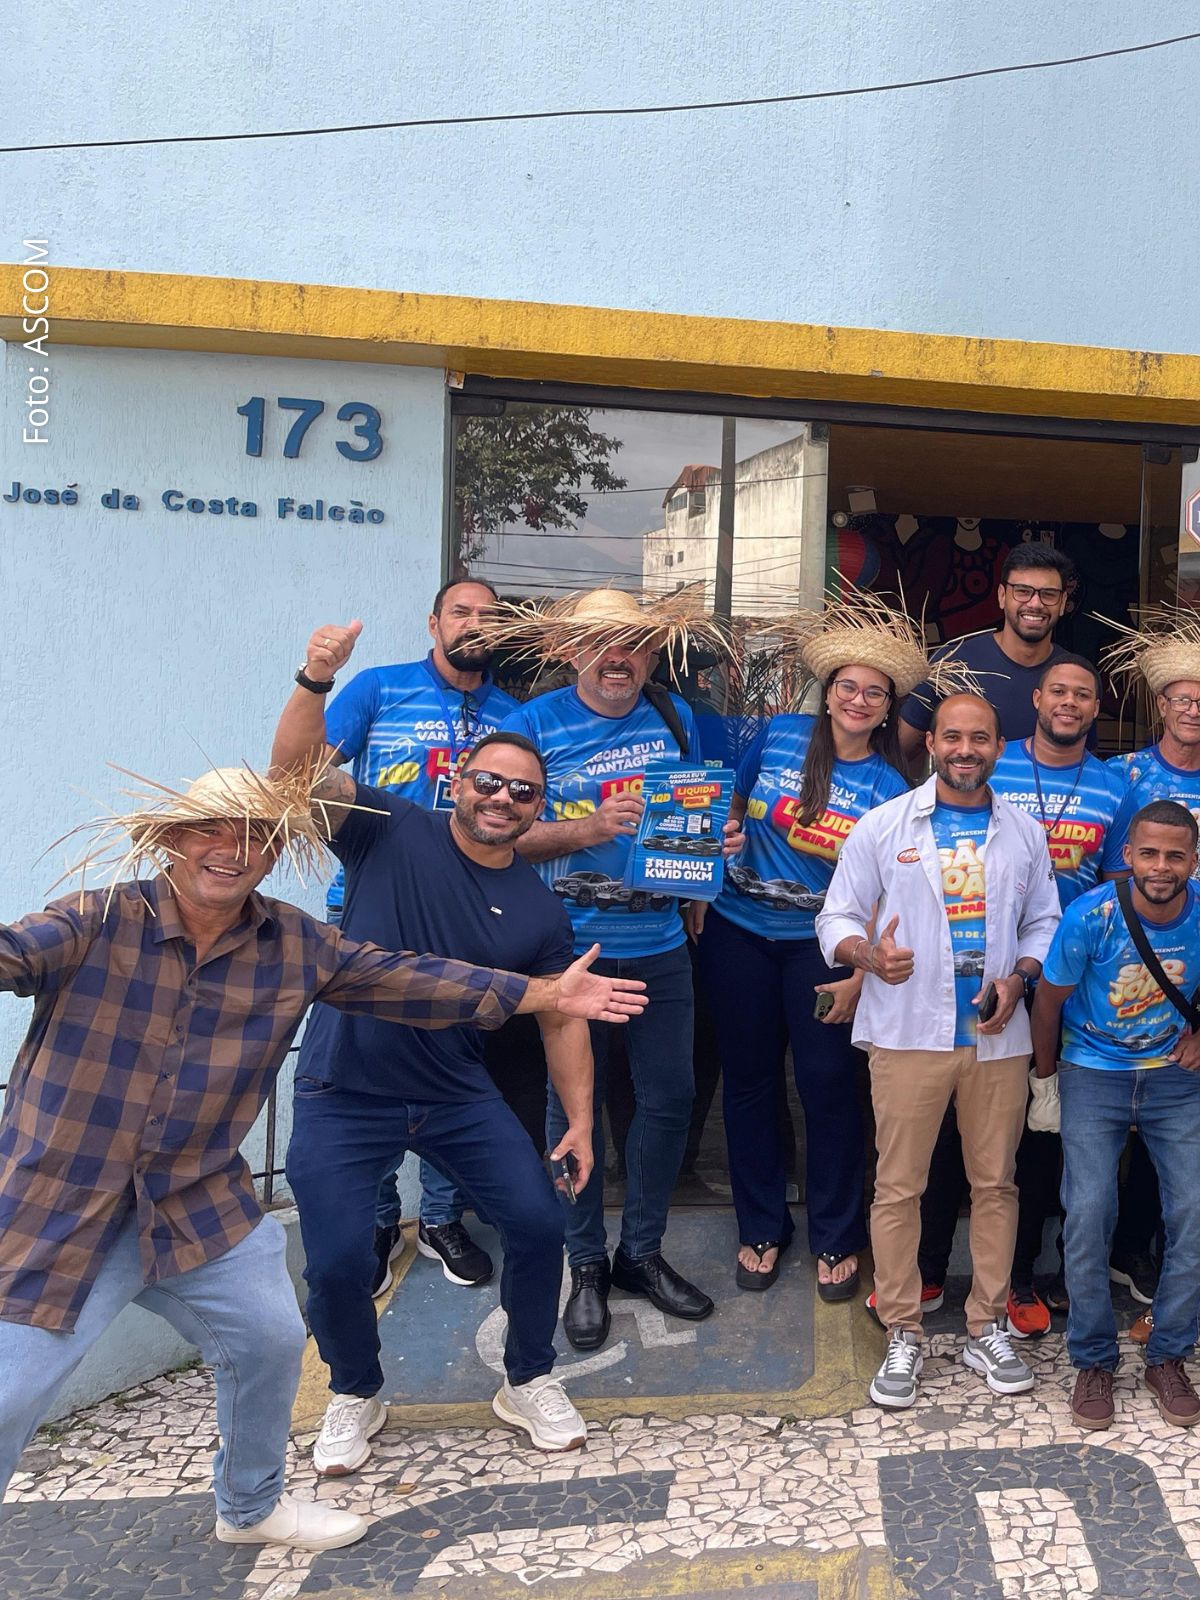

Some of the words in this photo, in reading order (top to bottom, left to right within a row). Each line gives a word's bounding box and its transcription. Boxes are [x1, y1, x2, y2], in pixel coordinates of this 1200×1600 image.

[237, 396, 384, 462] 173
[3, 482, 79, 506] José
[101, 488, 139, 511] da
[161, 489, 258, 518] Costa
[277, 496, 385, 525] Falcão
[632, 742, 650, 755] EU
[651, 739, 666, 752] VI
[677, 785, 716, 796] LIQUIDA
[845, 790, 857, 802] VI
[1069, 795, 1082, 805] VI
[1013, 803, 1078, 815] ANTAGEM!
[792, 827, 836, 851] FEIRA
[645, 857, 654, 868] 3
[655, 858, 714, 872] RENAULT
[644, 868, 682, 880] KWID
